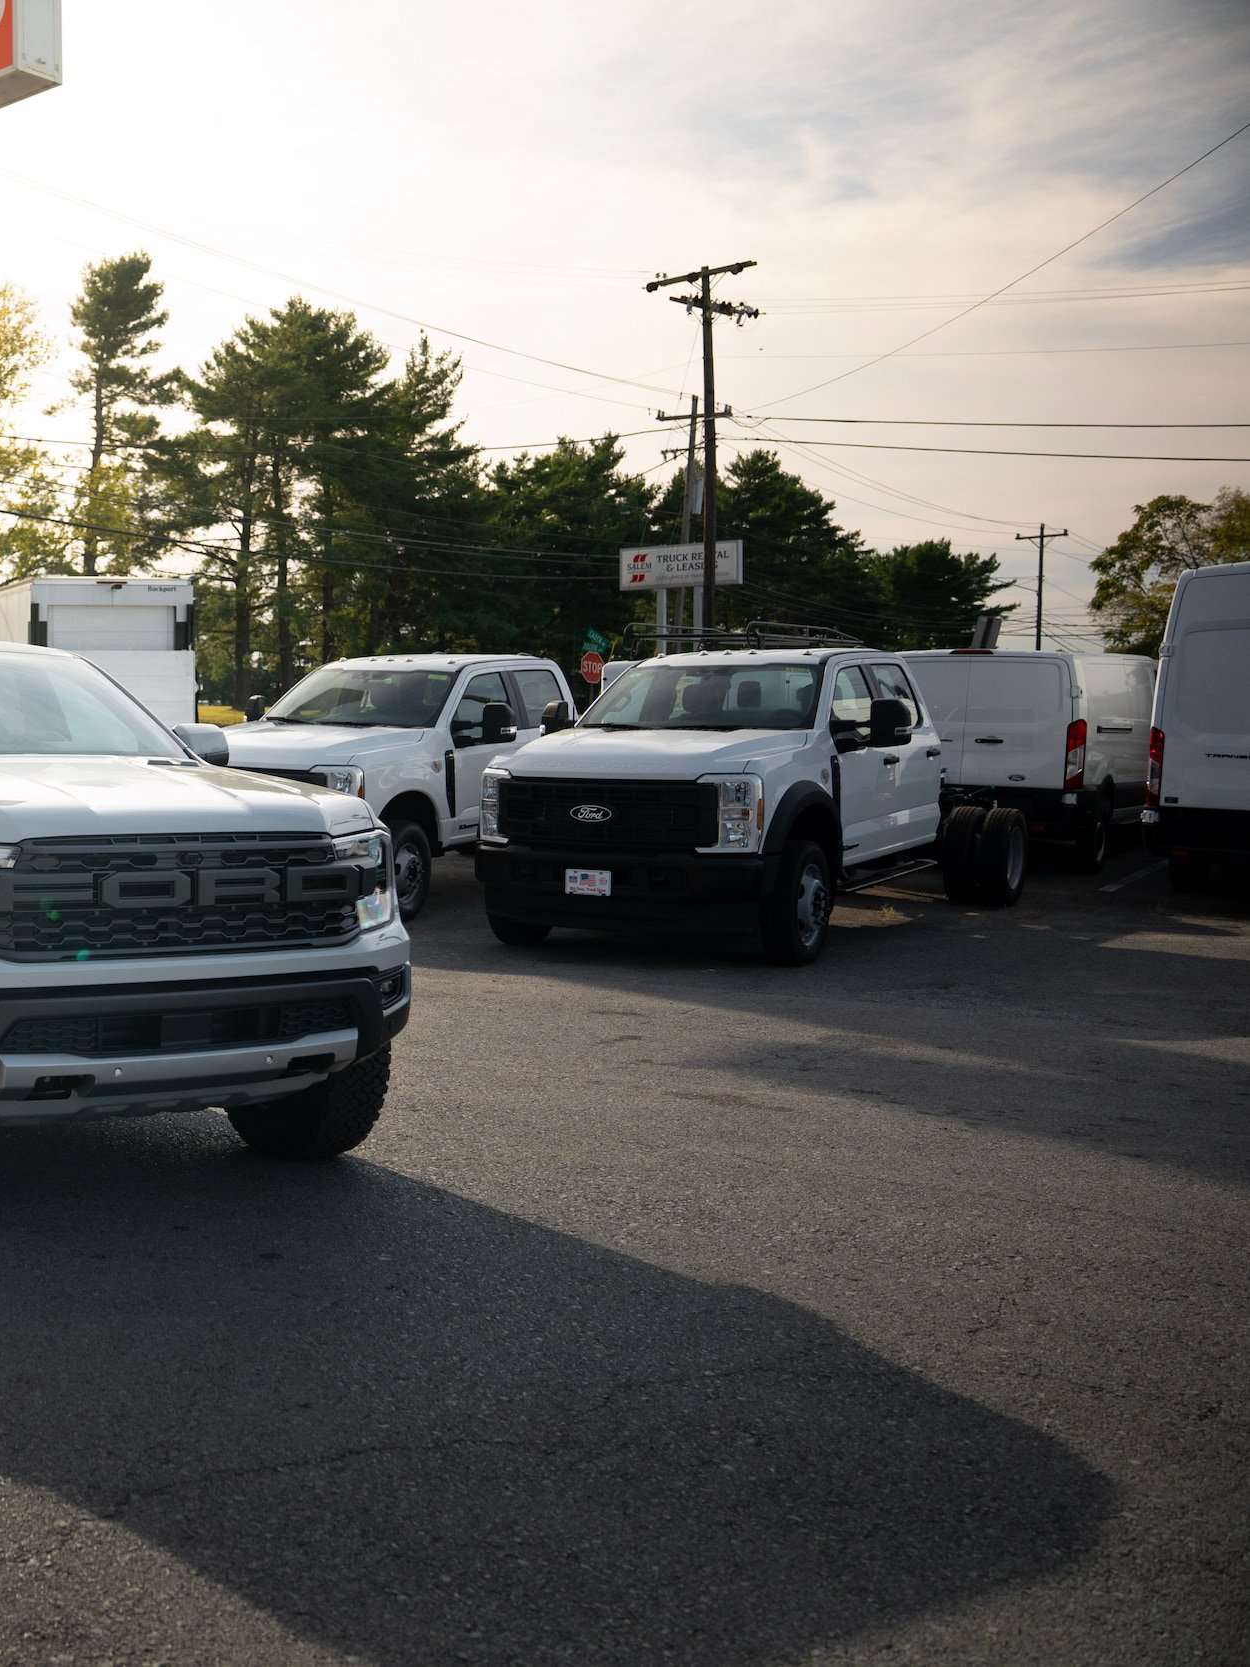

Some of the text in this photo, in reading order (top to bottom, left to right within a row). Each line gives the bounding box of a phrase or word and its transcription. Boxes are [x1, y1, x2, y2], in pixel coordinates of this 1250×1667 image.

[656, 550, 729, 563] TRUCK REAL
[627, 562, 652, 571] SALEM
[666, 560, 718, 572] & LEASI
[147, 585, 177, 593] Rockport
[582, 660, 602, 674] STOP
[577, 807, 604, 819] Ford
